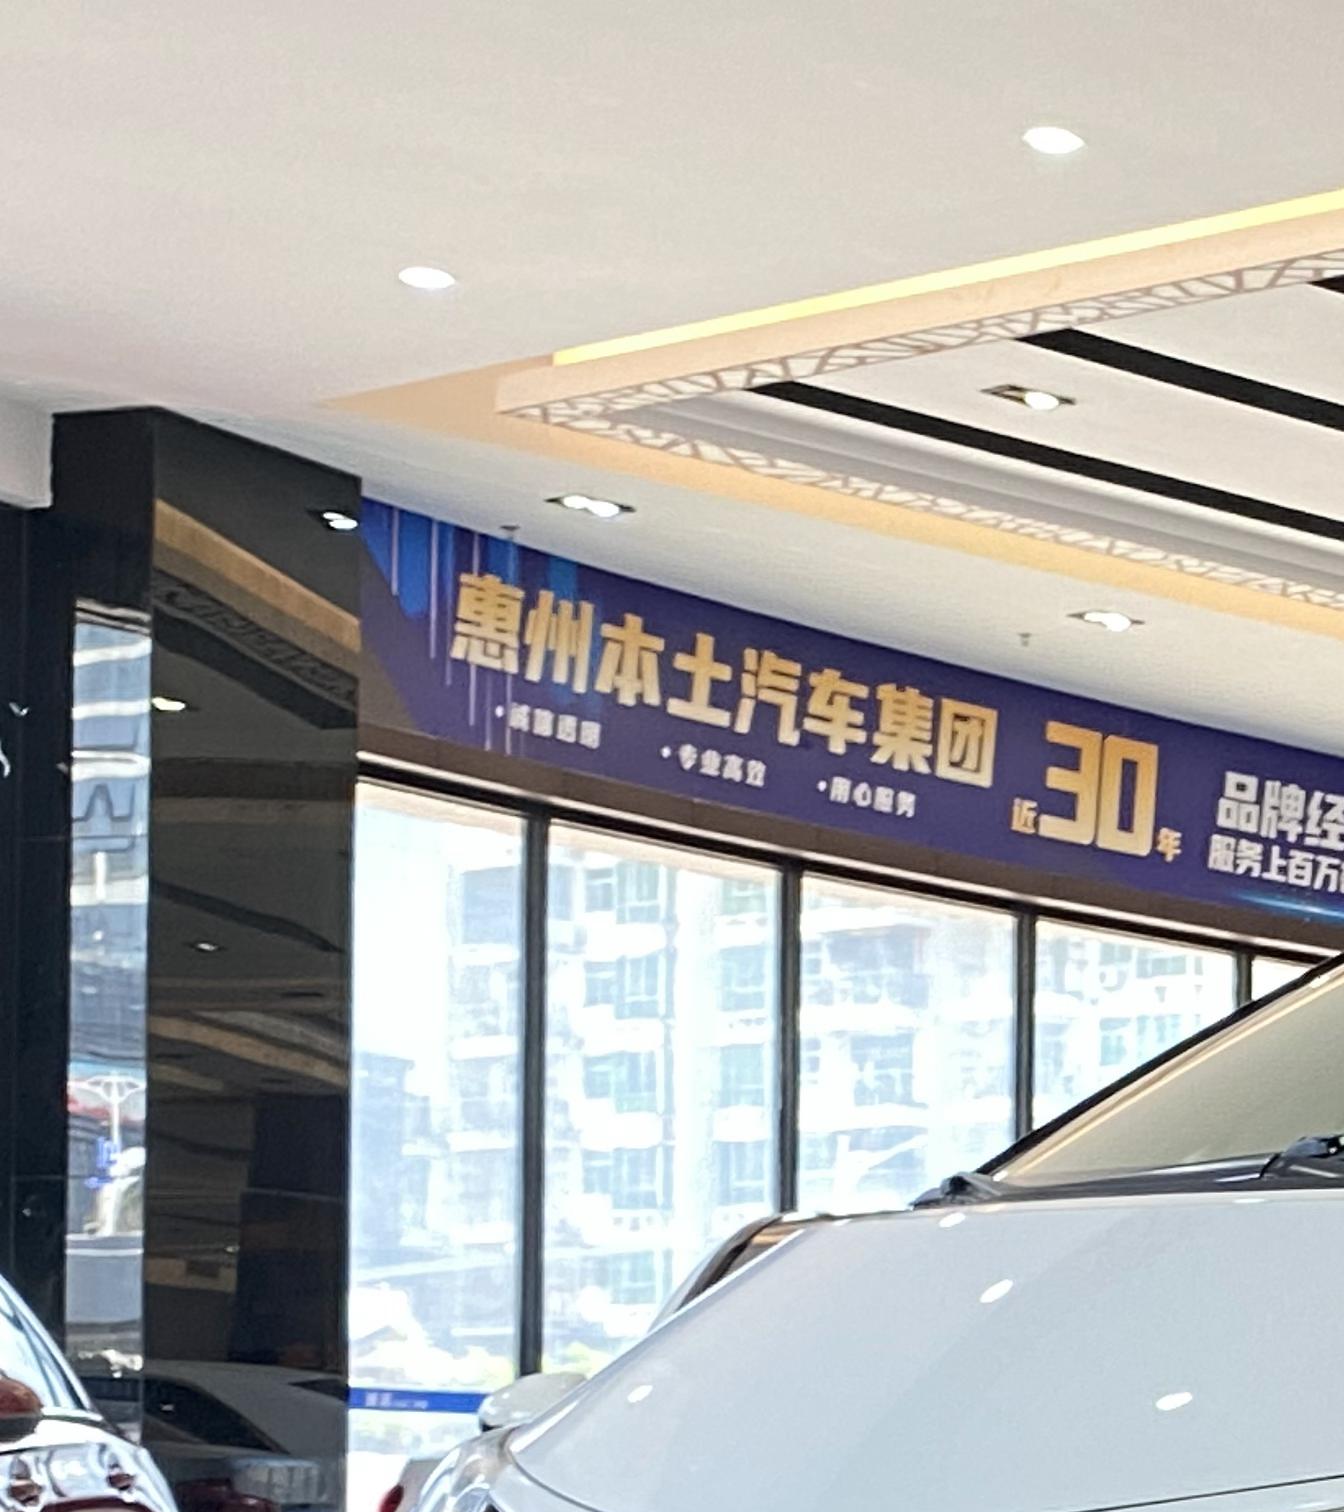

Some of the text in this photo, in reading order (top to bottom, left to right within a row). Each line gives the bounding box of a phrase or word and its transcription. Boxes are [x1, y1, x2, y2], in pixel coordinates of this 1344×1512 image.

[451, 572, 998, 788] 惠州本土汽车集团
